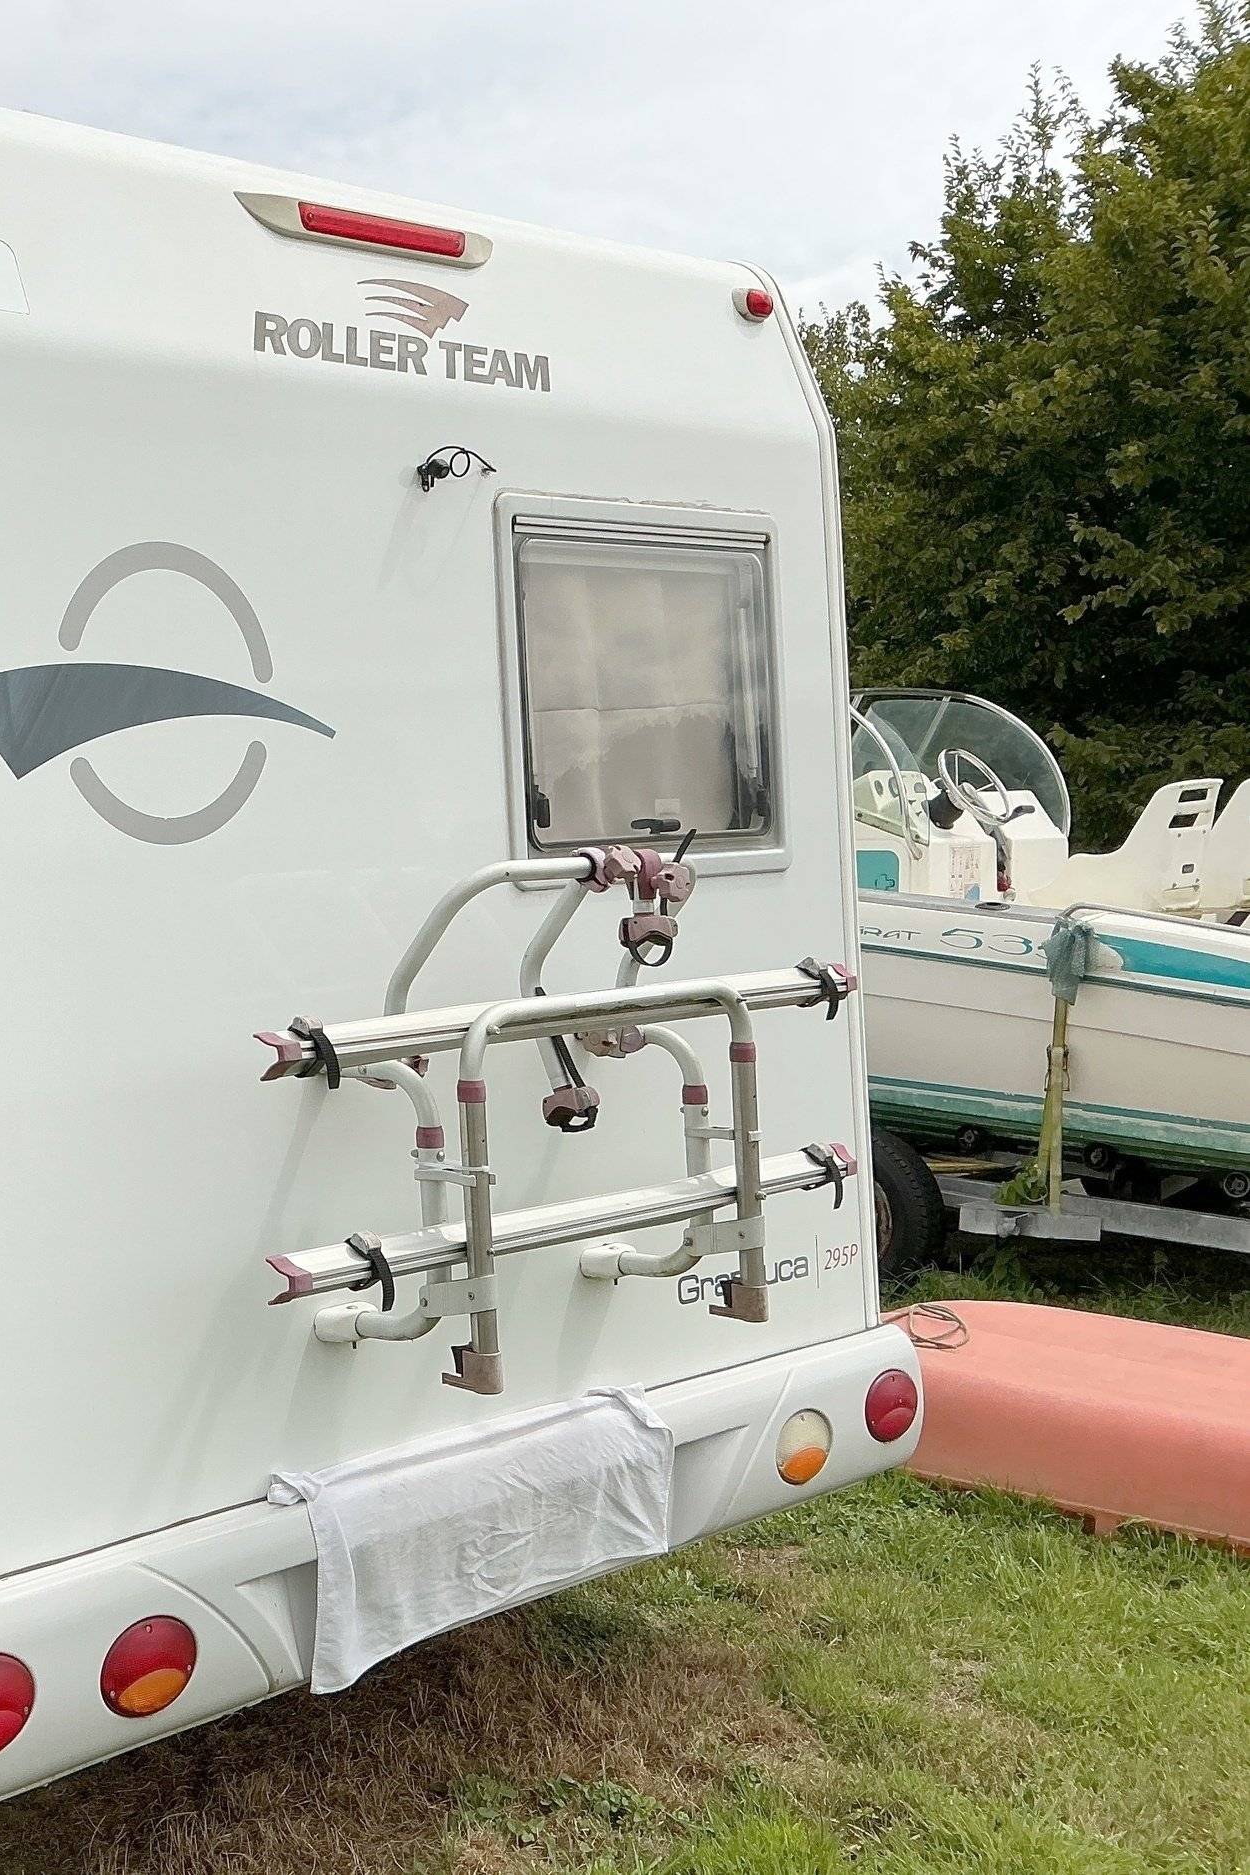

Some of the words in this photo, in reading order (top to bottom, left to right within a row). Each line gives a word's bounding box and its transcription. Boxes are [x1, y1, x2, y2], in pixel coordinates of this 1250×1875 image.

[253, 311, 428, 376] ROLLER
[438, 340, 551, 393] TEAM
[677, 1255, 810, 1305] Grauca
[824, 1243, 859, 1271] 295P
